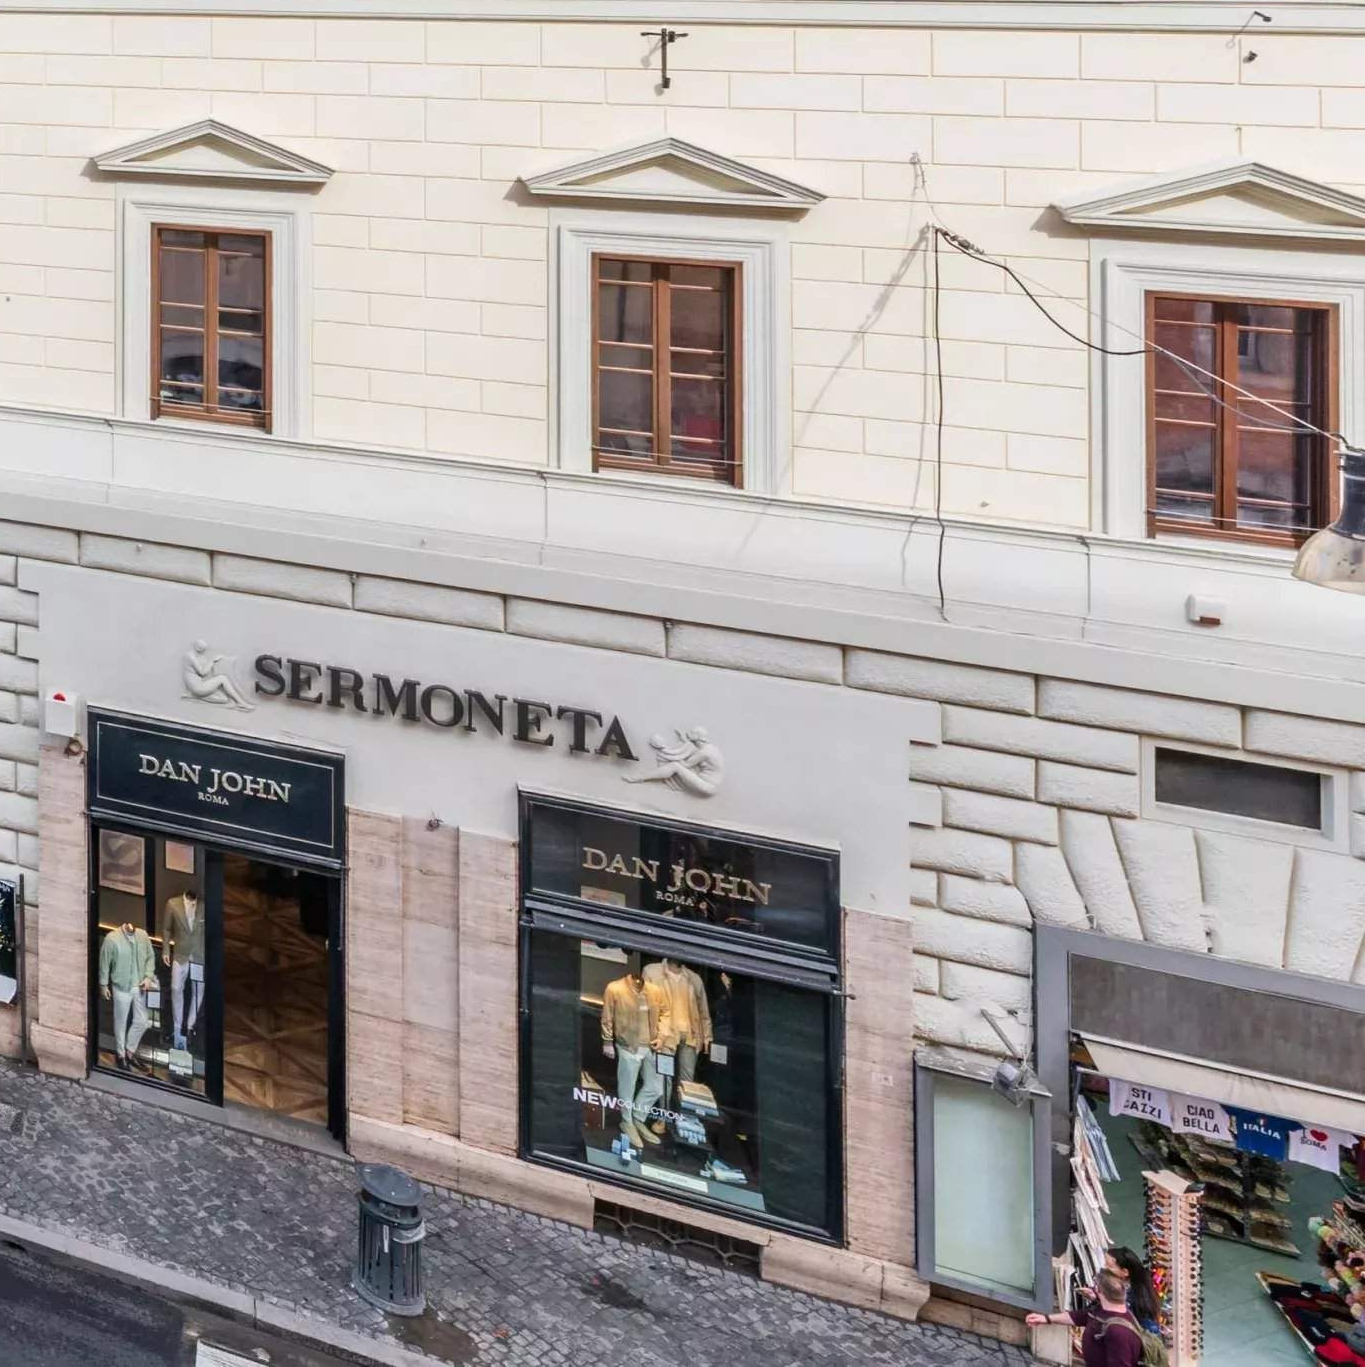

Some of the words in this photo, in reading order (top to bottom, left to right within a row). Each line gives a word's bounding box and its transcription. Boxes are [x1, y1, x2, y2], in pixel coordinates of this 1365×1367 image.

[254, 653, 640, 762] SERMONETA
[138, 754, 202, 785] DAN
[206, 768, 292, 803] JOHN
[198, 792, 230, 806] ROMA
[582, 846, 660, 882] DAN
[666, 864, 773, 906] JOHN
[654, 890, 694, 907] ROMA
[1131, 1087, 1152, 1101] STI
[1187, 1105, 1215, 1120] CIAO
[1183, 1116, 1220, 1134] BELLA
[1243, 1123, 1282, 1140] ITALIA
